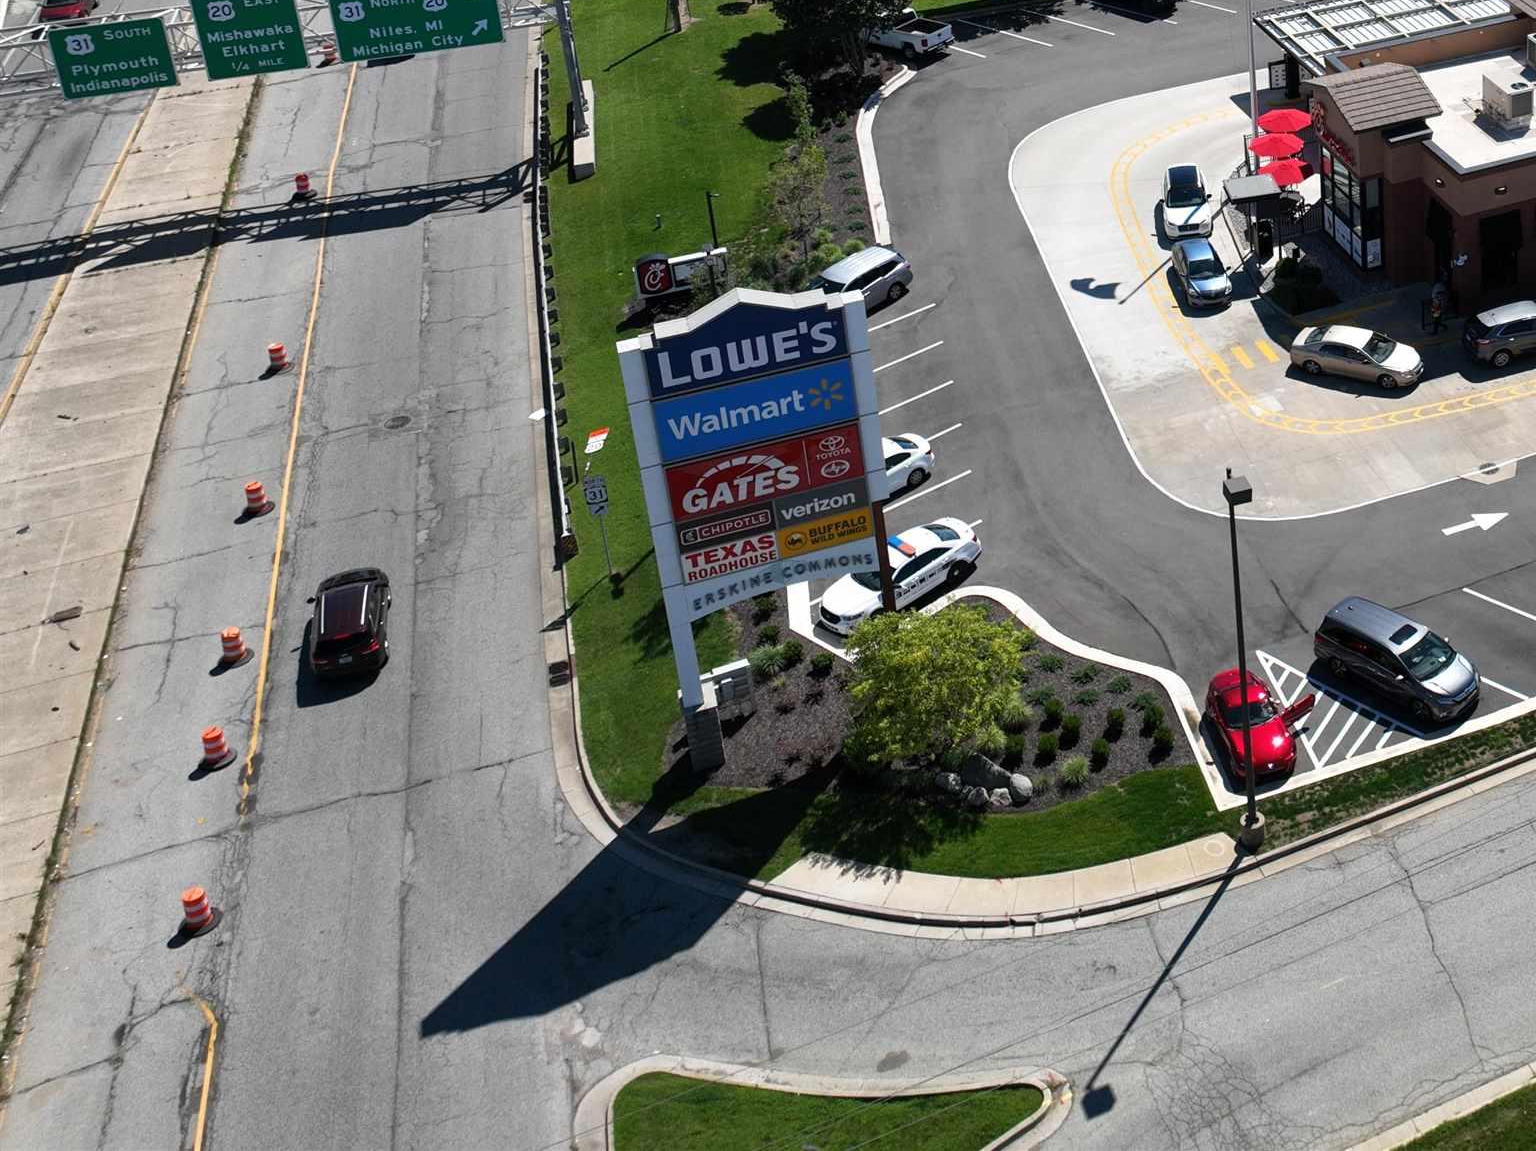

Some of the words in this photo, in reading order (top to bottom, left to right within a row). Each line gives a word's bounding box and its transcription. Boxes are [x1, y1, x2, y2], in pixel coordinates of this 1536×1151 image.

[211, 5, 232, 18] 20
[345, 6, 361, 18] 31
[207, 24, 294, 43] Mishawaka
[425, 20, 443, 32] MI
[72, 38, 90, 51] 31
[104, 27, 151, 40] SOUTH
[222, 40, 286, 57] Elkhart
[352, 40, 423, 57] Michigan
[432, 34, 464, 47] City
[71, 56, 159, 76] Plymouth
[258, 58, 285, 67] MILE
[70, 72, 168, 93] Indianapolis
[657, 321, 838, 388] LOWE'S
[667, 390, 805, 440] Walmart
[816, 447, 852, 460] TOYOTA
[589, 490, 604, 501] 31
[683, 465, 800, 514] GATES
[782, 492, 856, 520] verizon
[701, 512, 768, 537] CHIPOTLE
[809, 515, 866, 538] BUFFALO
[810, 531, 836, 545] WILD
[837, 525, 868, 539] WINGS
[685, 535, 775, 568] TEXAS
[688, 550, 778, 581] ROADHOUSE
[693, 571, 774, 611] ERSKINE
[781, 553, 874, 578] COMMONS
